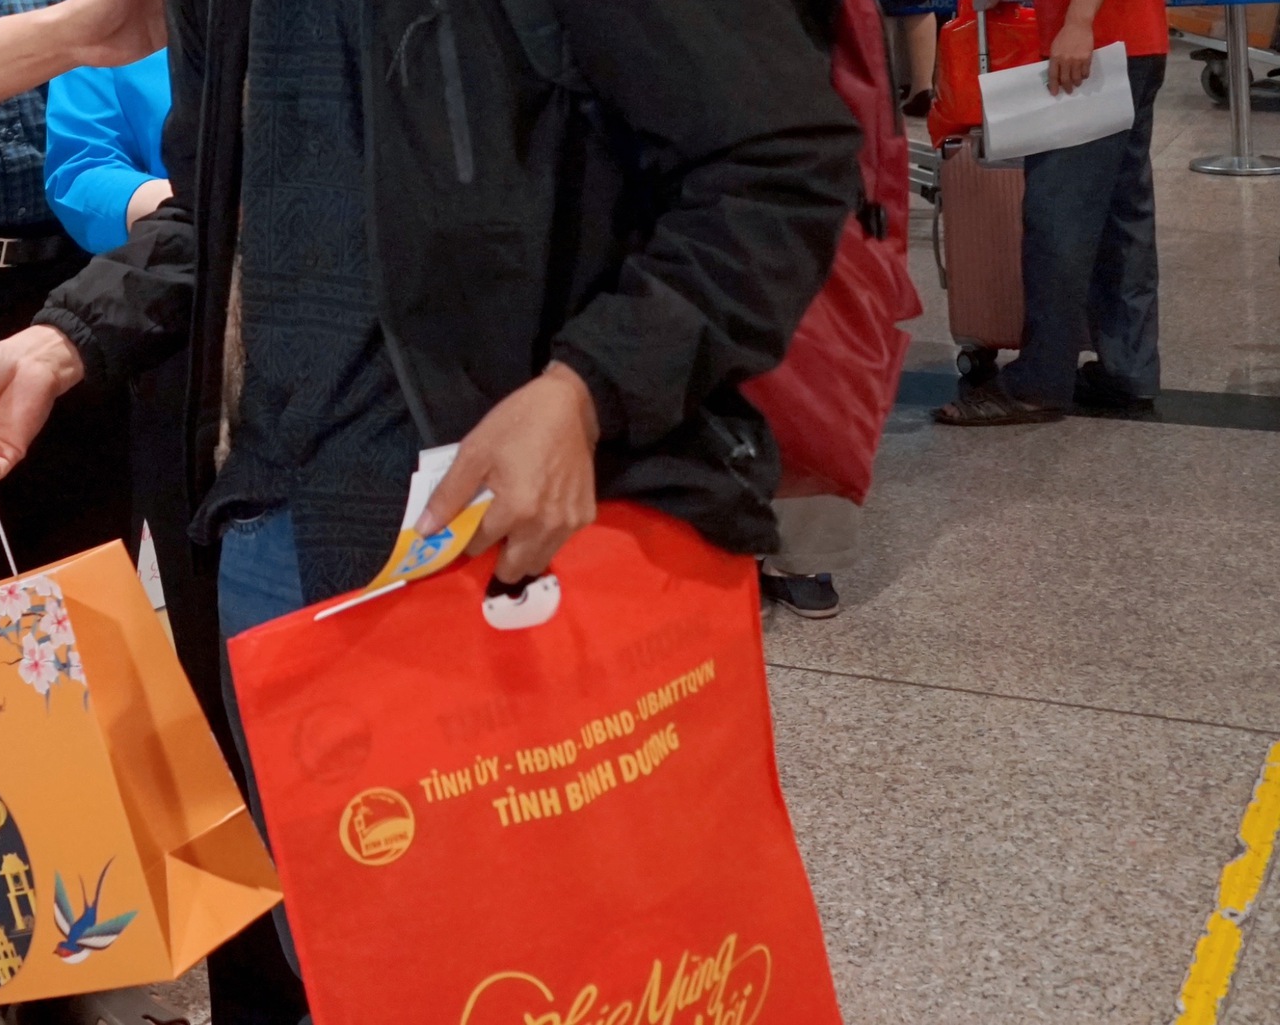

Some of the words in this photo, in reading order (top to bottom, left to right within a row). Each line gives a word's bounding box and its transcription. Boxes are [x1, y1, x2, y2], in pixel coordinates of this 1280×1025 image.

[420, 768, 472, 803] TỈNH
[474, 754, 499, 786] ỦY
[492, 785, 563, 827] TỈNH
[565, 759, 617, 812] BÌNH
[618, 722, 680, 784] DƯƠNG
